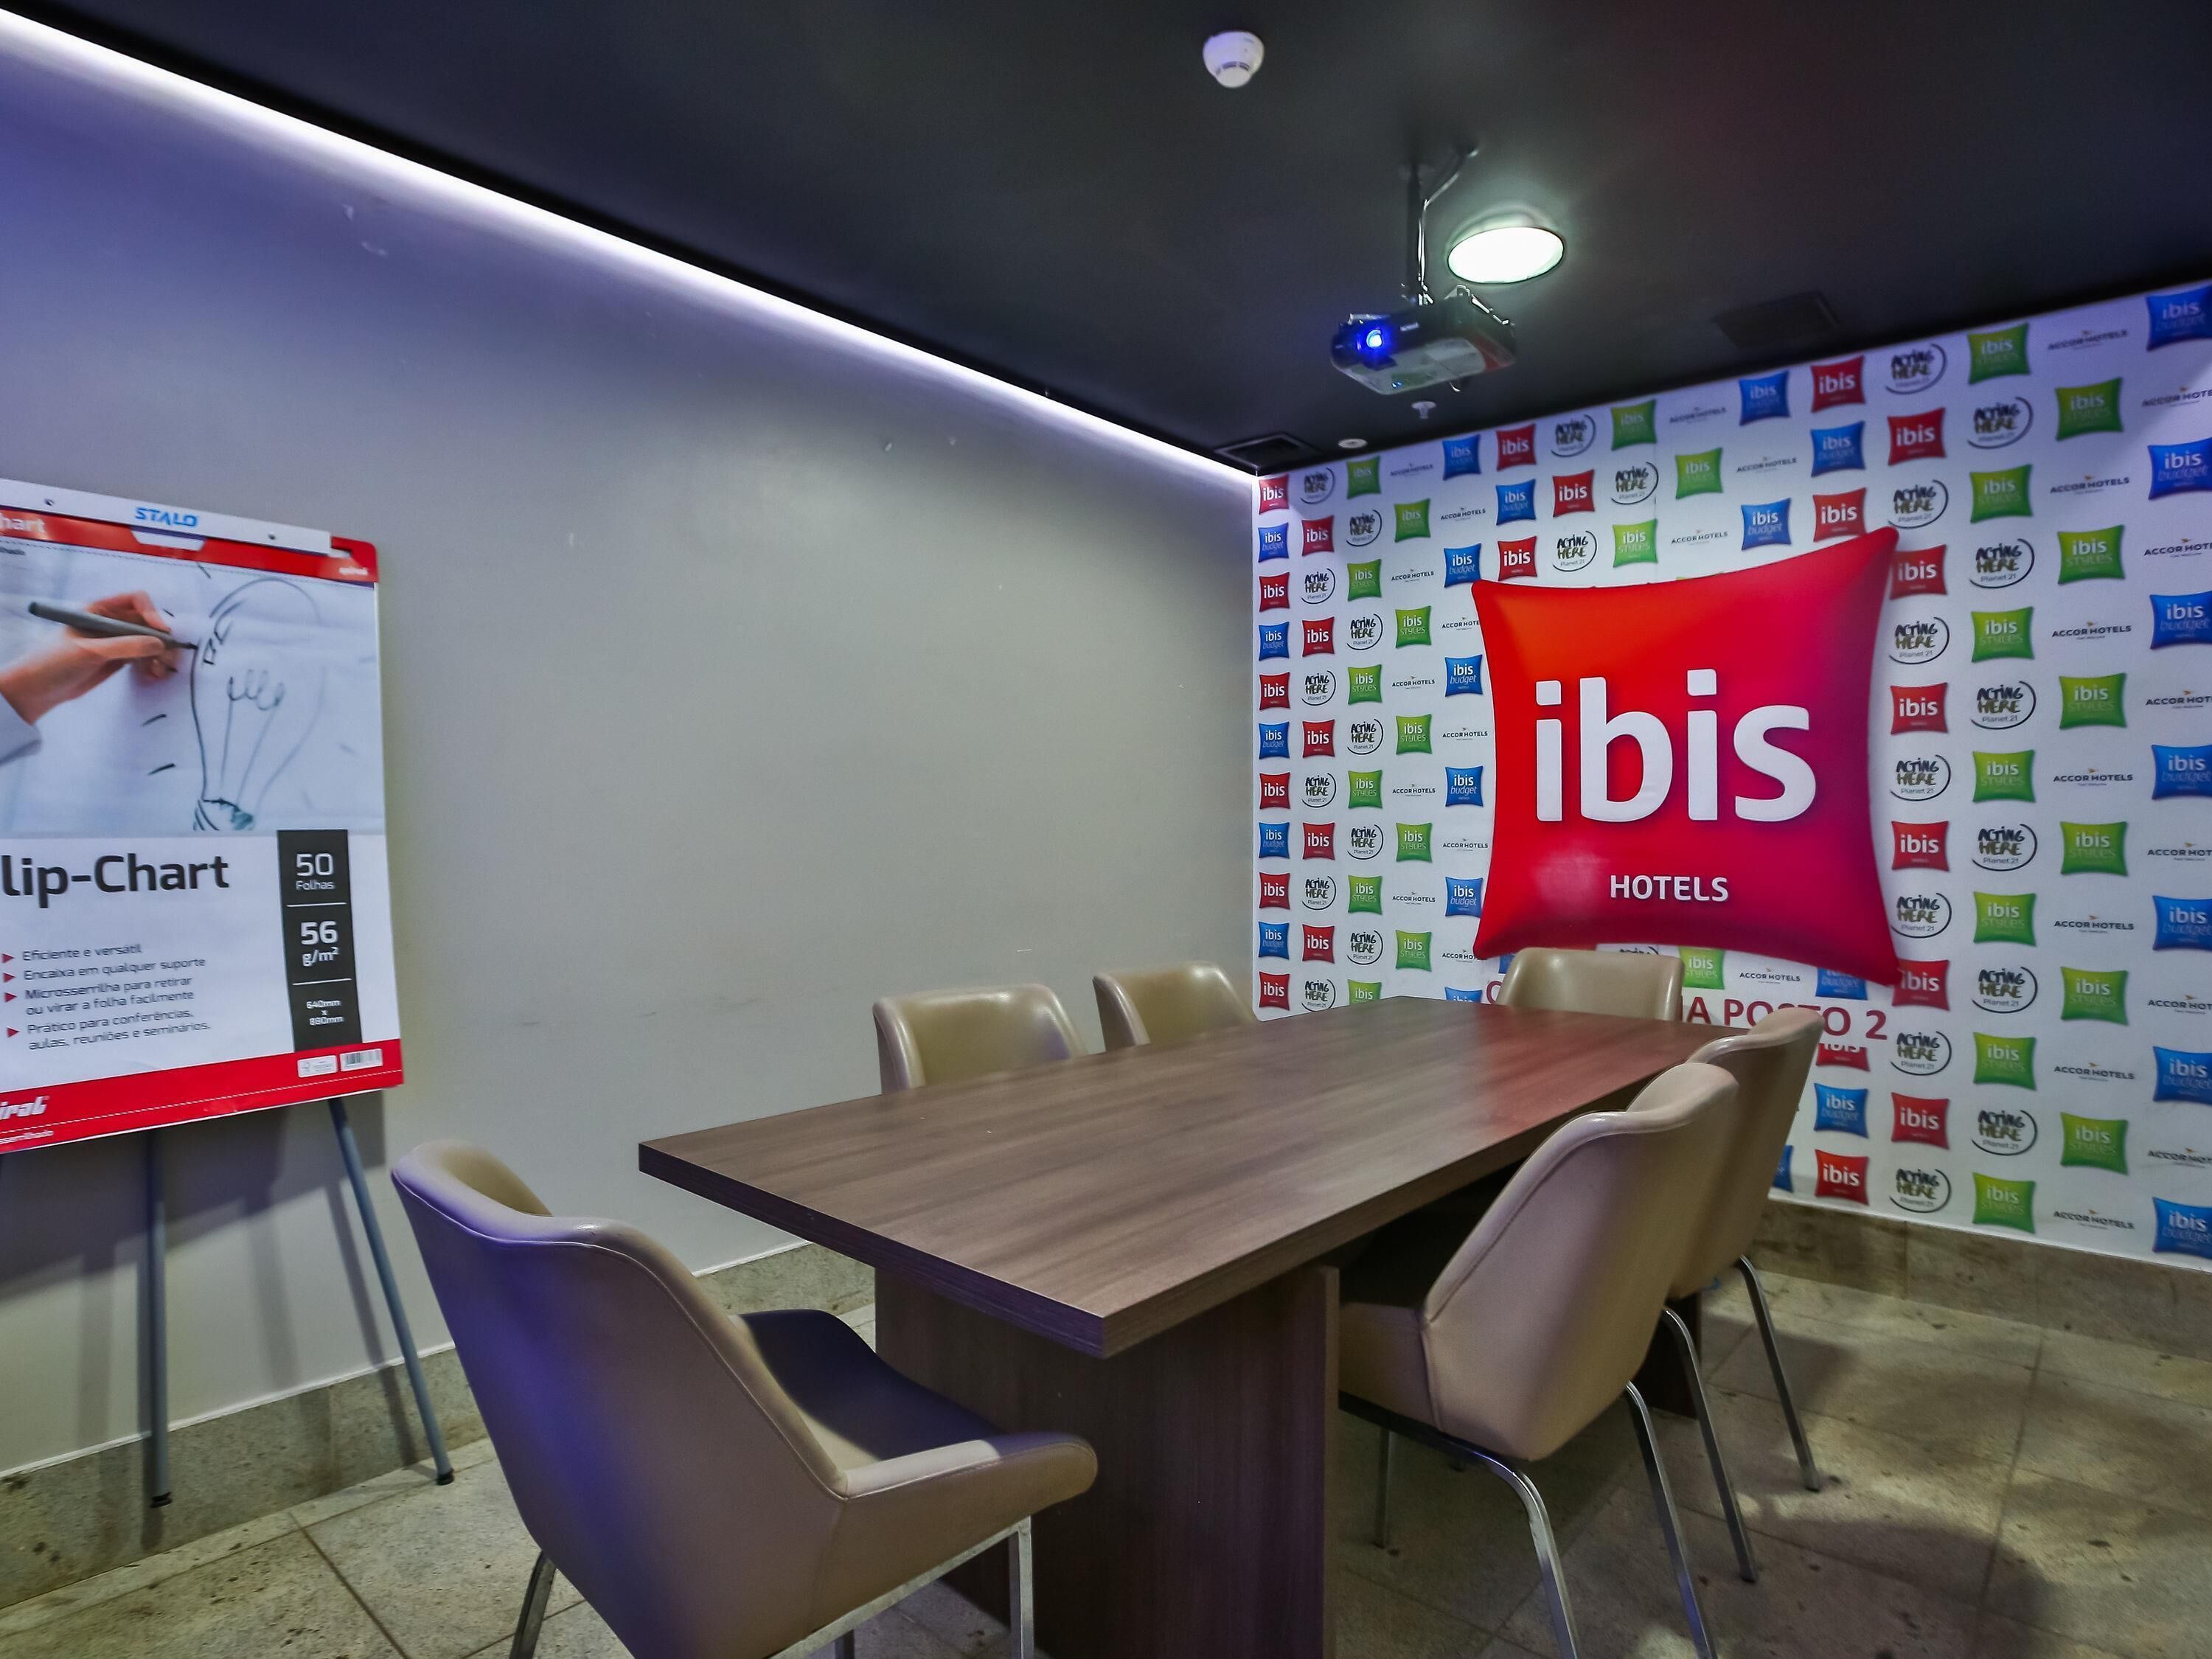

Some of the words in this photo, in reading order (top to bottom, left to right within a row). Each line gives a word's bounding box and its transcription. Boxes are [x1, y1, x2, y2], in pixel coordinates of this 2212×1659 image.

[1820, 374, 1854, 393] ibis
[1897, 425, 1935, 445] ibis
[1503, 439, 1528, 454] ibis
[2166, 453, 2202, 468] ibis
[1262, 484, 1283, 501] ibis
[1559, 484, 1587, 501] ibis
[136, 507, 198, 527] STALO
[1753, 512, 1778, 525] ibis
[1822, 504, 1857, 524] ibis
[1265, 532, 1283, 543] ibis
[1307, 529, 1327, 542] ibis
[1623, 531, 1645, 546] ibis
[1557, 547, 1587, 560] HERE
[2073, 540, 2107, 554] ibis
[1453, 554, 1472, 566] ibis
[1504, 549, 1530, 566] ibis
[1899, 561, 1936, 580] ibis
[1977, 559, 2018, 573] HERE
[1265, 584, 1284, 598] ibis
[1305, 582, 1327, 593] HERE
[2168, 605, 2203, 619] ibis
[1404, 616, 1422, 627] ibis
[1986, 621, 2017, 634] ibis
[1266, 631, 1281, 641] ibis
[1308, 629, 1329, 643] ibis
[1351, 627, 1374, 639] HERE
[1896, 636, 1935, 650] HERE
[1454, 664, 1472, 675] ibis
[1356, 673, 1373, 686] ibis
[1265, 684, 1284, 697] ibis
[1305, 684, 1327, 694] HERE
[2075, 686, 2107, 700] ibis
[1900, 698, 1937, 716] ibis
[1978, 700, 2020, 713] HERE
[1266, 730, 1281, 740] ibis
[1405, 723, 1424, 736] ibis
[1308, 731, 1329, 744] ibis
[1351, 732, 1375, 743] HERE
[1537, 669, 1815, 821] ibis
[1987, 762, 2018, 775] ibis
[2169, 756, 2205, 771] ibis
[1357, 779, 1373, 788] ibis
[1455, 775, 1473, 787] ibis
[1897, 771, 1935, 786] HERE
[1265, 783, 1284, 796] ibis
[1306, 786, 1328, 796] HERE
[1266, 830, 1281, 840] ibis
[1308, 833, 1329, 846] ibis
[1405, 831, 1422, 841] ibis
[2076, 832, 2110, 847] ibis
[1351, 838, 1375, 848] HERE
[1901, 835, 1938, 852] ibis
[1979, 840, 2022, 855] HERE
[296, 853, 333, 876] 50
[1, 853, 229, 908] lip-Chart
[296, 879, 335, 891] Folhas
[1265, 883, 1284, 896] ibis
[1306, 888, 1328, 900] HERE
[1357, 883, 1373, 894] ibis
[1455, 886, 1473, 899] ibis
[1610, 874, 1728, 902] HOTELS
[1897, 906, 1937, 923] HERE
[1988, 903, 2019, 917] ibis
[2170, 908, 2206, 923] ibis
[300, 921, 337, 945] 56
[1266, 930, 1281, 939] ibis
[1308, 936, 1329, 949] ibis
[1351, 942, 1374, 953] HERE
[1404, 939, 1422, 952] ibis
[22, 948, 79, 961] Eficiente
[24, 968, 74, 980] Encaixa
[79, 966, 99, 975] em
[102, 962, 156, 975] qualquer
[160, 959, 206, 970] suporte
[1689, 957, 1713, 969] ibis
[124, 981, 150, 991] para
[154, 977, 192, 987] retirar
[1265, 982, 1284, 996] ibis
[2076, 979, 2110, 995] ibis
[1980, 984, 2021, 999] HERE
[26, 1006, 43, 1015] ou
[47, 1003, 78, 1013] virar
[94, 997, 127, 1006] folha
[80, 1018, 108, 1030] para
[1724, 999, 1851, 1035] POO
[1866, 1010, 1887, 1040] 2
[1988, 1046, 2019, 1060] ibis
[2171, 1062, 2207, 1077] ibis
[1826, 1094, 1854, 1110] ibis
[1901, 1109, 1938, 1129] ibis
[2076, 1127, 2110, 1144] ibis
[1823, 1164, 1859, 1186] ibis
[2169, 1211, 2206, 1231] ibis
